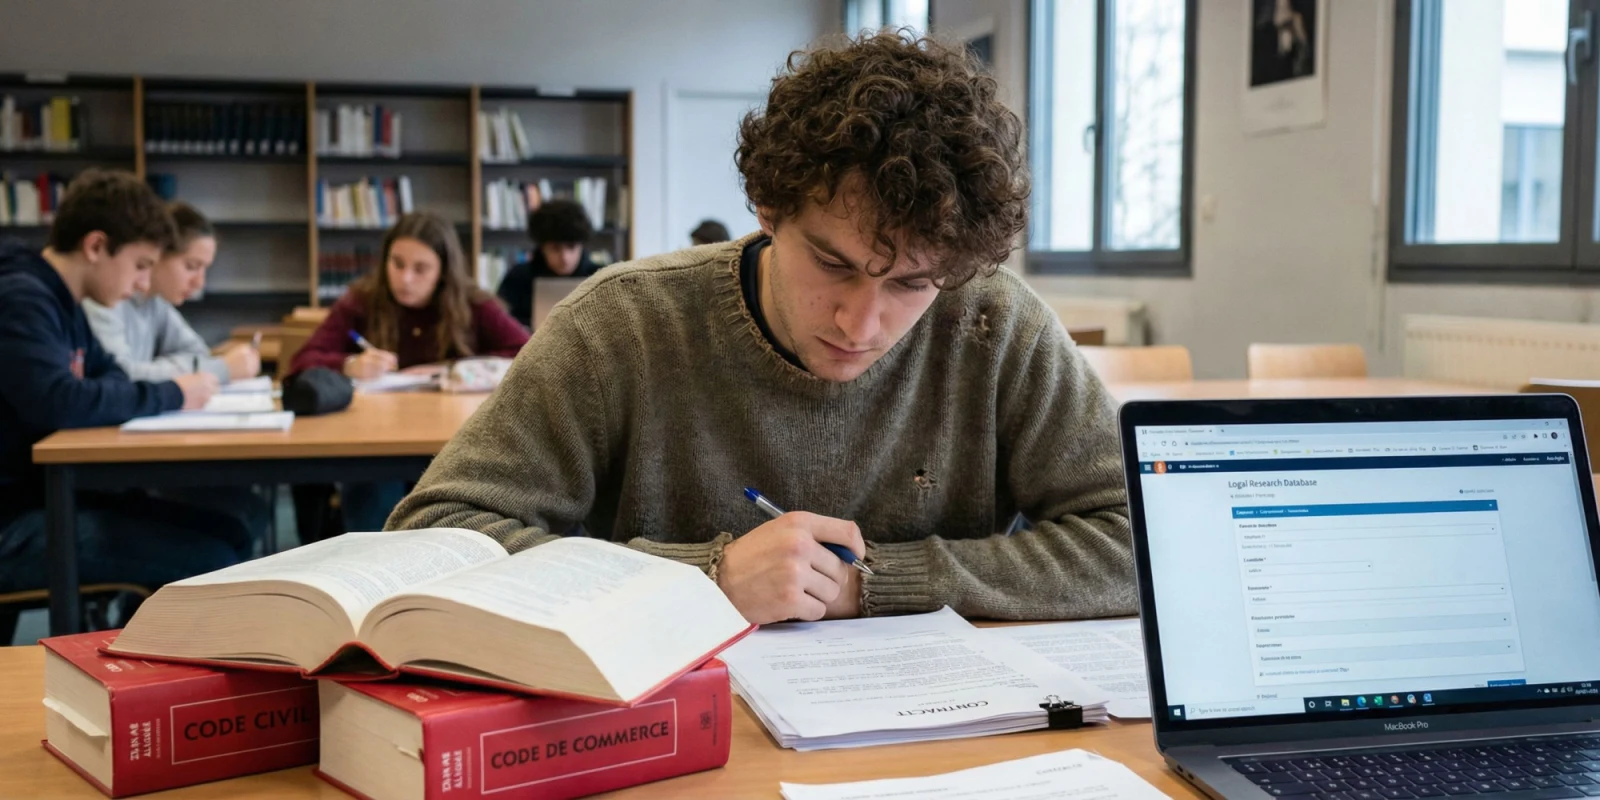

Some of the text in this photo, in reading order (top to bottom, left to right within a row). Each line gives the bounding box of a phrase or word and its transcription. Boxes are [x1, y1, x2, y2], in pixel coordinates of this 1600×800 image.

[1249, 478, 1283, 488] Research
[1283, 478, 1318, 487] Database
[183, 715, 246, 741] CODE
[254, 706, 310, 730] CIVIL
[1384, 720, 1429, 731] MacBook Pro
[490, 745, 540, 770] CODE
[546, 741, 568, 759] DE
[572, 721, 669, 753] COMMERCE
